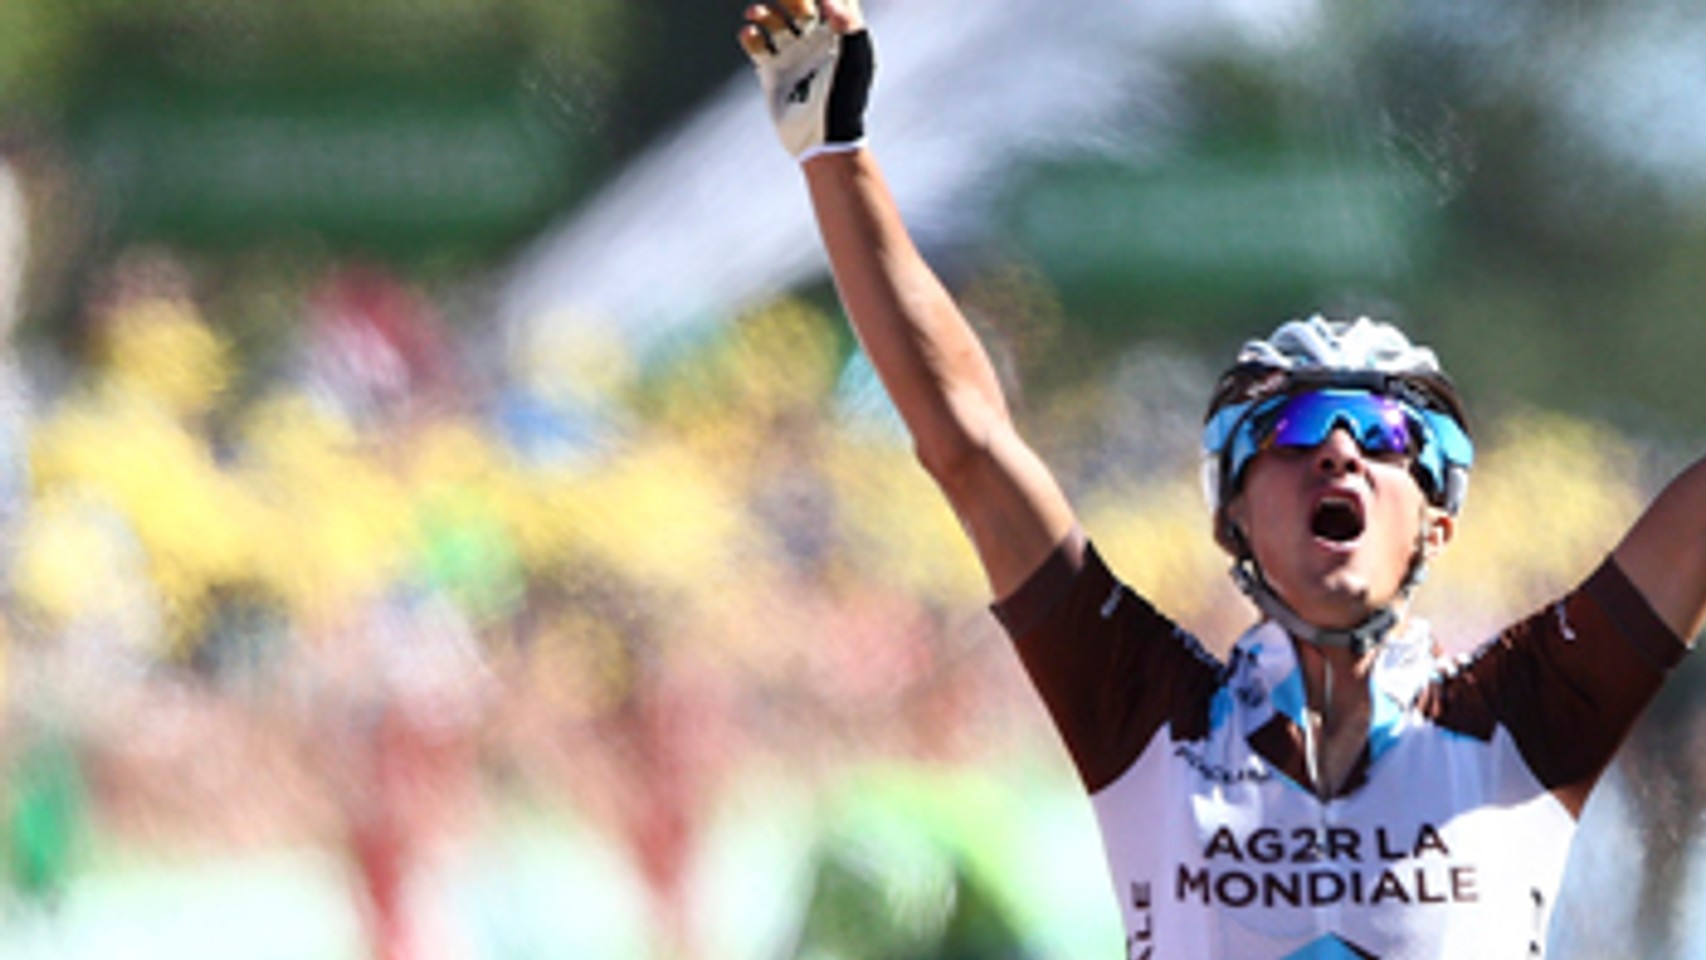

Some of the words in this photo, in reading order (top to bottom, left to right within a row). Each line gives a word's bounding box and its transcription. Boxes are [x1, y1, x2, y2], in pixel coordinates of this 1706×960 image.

[1203, 824, 1363, 863] AG2R
[1377, 823, 1450, 860] LA
[1174, 864, 1480, 907] MONDIALE
